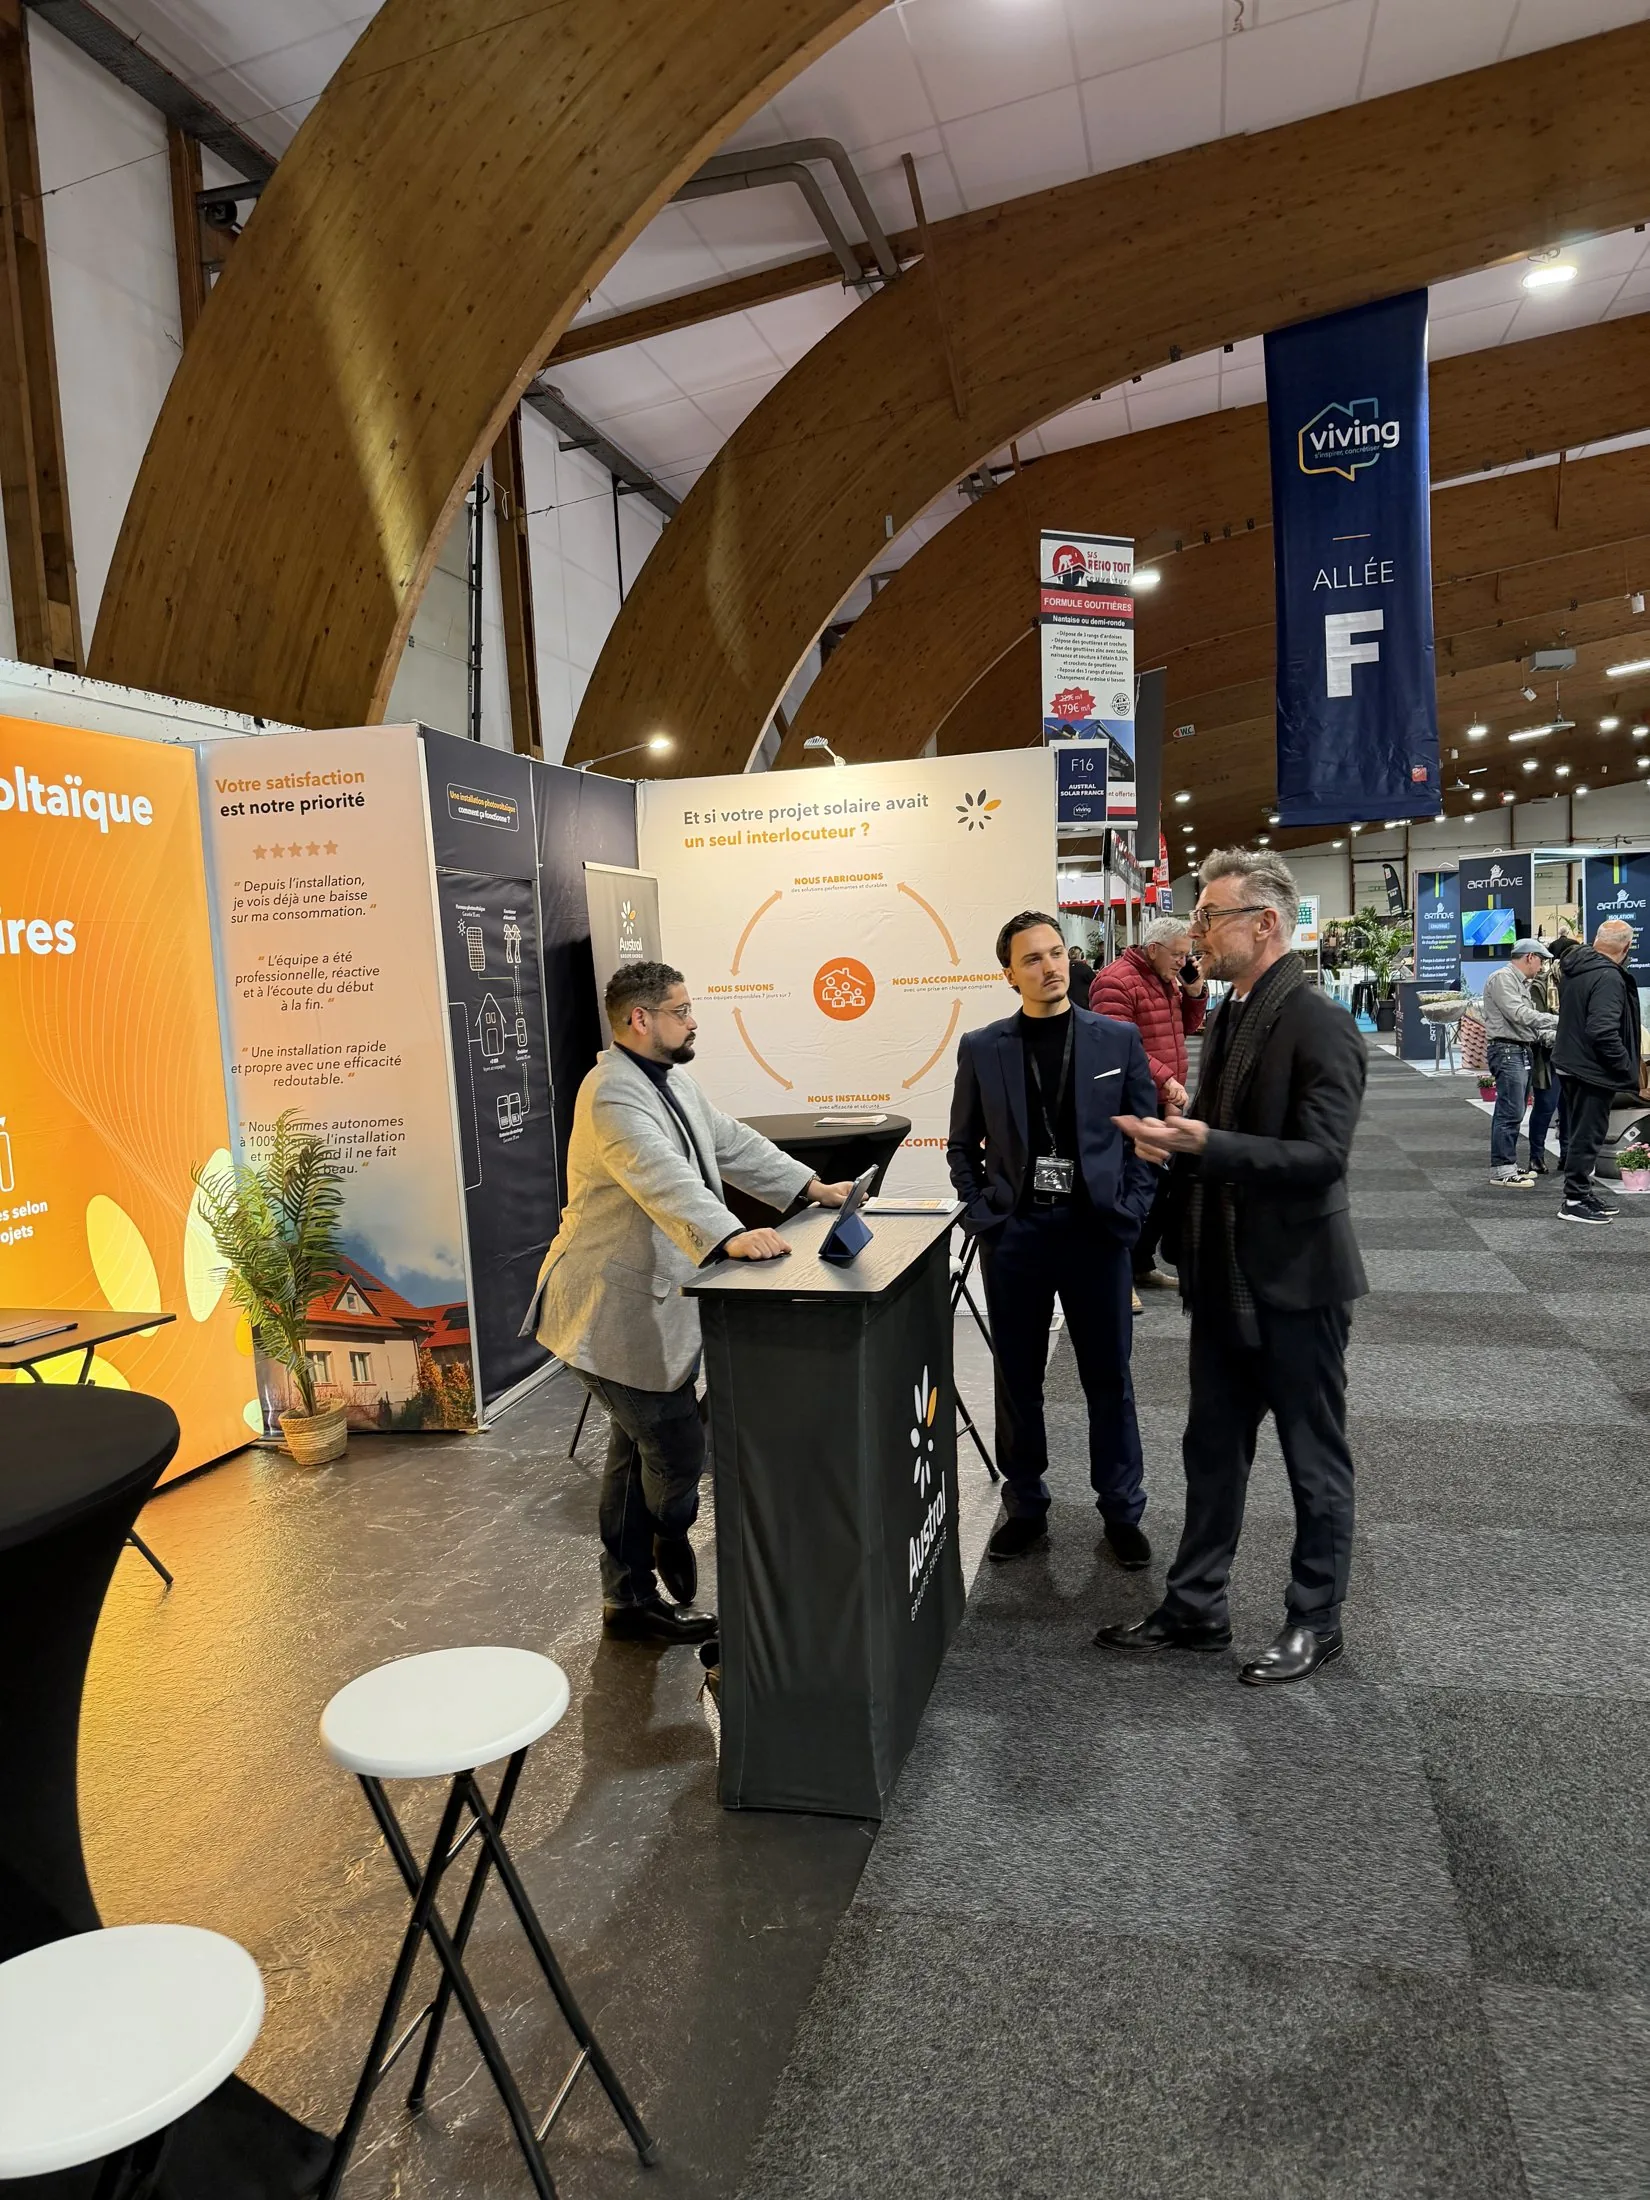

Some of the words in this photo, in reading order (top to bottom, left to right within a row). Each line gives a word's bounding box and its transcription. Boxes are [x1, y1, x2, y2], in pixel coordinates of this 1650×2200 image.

[1309, 419, 1400, 451] viving
[1113, 562, 1130, 573] TOIT
[1312, 557, 1395, 591] ALLÉE
[1044, 597, 1082, 608] FORMULE
[1084, 600, 1132, 612] GOUTTIÈRES
[1053, 615, 1080, 624] Nantaise
[1091, 618, 1125, 627] demi-ronde
[1324, 608, 1384, 698] F
[1058, 702, 1080, 715] 179€
[1071, 758, 1094, 772] F16
[215, 777, 262, 794] Votre
[266, 769, 365, 790] satisfaction
[220, 802, 245, 817] est
[250, 799, 295, 815] notre
[300, 792, 365, 815] priorité
[683, 811, 699, 825] Et
[703, 809, 716, 823] si
[721, 807, 764, 822] votre
[769, 802, 819, 823] projet
[823, 797, 881, 815] solaire
[886, 793, 929, 810] avait
[684, 836, 704, 849] un
[709, 830, 742, 847] seul
[747, 825, 856, 845] interlocuteur
[860, 821, 870, 837] ?
[244, 879, 286, 895] Depuis
[289, 875, 365, 890] l'installation,
[794, 876, 821, 885] NOUS
[822, 872, 884, 883] FABRIQUONS
[233, 896, 244, 911] je
[247, 893, 270, 908] vois
[273, 892, 299, 908] déjà
[303, 893, 326, 904] une
[329, 890, 368, 902] baisse
[231, 914, 249, 924] sur
[251, 912, 269, 923] ma
[272, 906, 366, 922] consommation.
[267, 953, 319, 968] L'équipe
[322, 955, 329, 964] a
[333, 951, 353, 964] été
[235, 967, 328, 987] professionnelle,
[331, 966, 380, 979] réactive
[892, 977, 919, 986] NOUS
[921, 973, 1004, 985] ACCOMPAGNONS
[243, 988, 254, 998] et
[256, 986, 264, 998] à
[267, 984, 314, 997] l'écoute
[317, 982, 333, 994] du
[336, 981, 375, 994] début
[708, 985, 733, 993] NOUS
[734, 983, 774, 992] SUIVONS
[281, 999, 288, 1011] à
[291, 998, 302, 1011] la
[305, 997, 324, 1010] fin.
[251, 1046, 274, 1058] Une
[277, 1043, 342, 1057] installation
[345, 1040, 387, 1055] rapide
[231, 1064, 242, 1074] et
[244, 1061, 283, 1076] propre
[285, 1060, 314, 1071] avec
[316, 1059, 341, 1070] une
[344, 1055, 402, 1069] efficacité
[273, 1073, 344, 1087] redoutable.
[807, 1095, 833, 1103] NOUS
[835, 1093, 891, 1102] INSTALLONS
[248, 1121, 277, 1133] Nous
[277, 1121, 328, 1132] ommes
[331, 1116, 404, 1130] autonomes
[239, 1137, 246, 1147] à
[326, 1131, 406, 1145] l'installation
[899, 1137, 949, 1150] comp
[250, 1152, 261, 1162] et
[345, 1148, 352, 1158] il
[356, 1150, 372, 1159] ne
[376, 1146, 397, 1157] fait
[323, 1162, 358, 1175] beau.
[12, 1200, 49, 1219] selon
